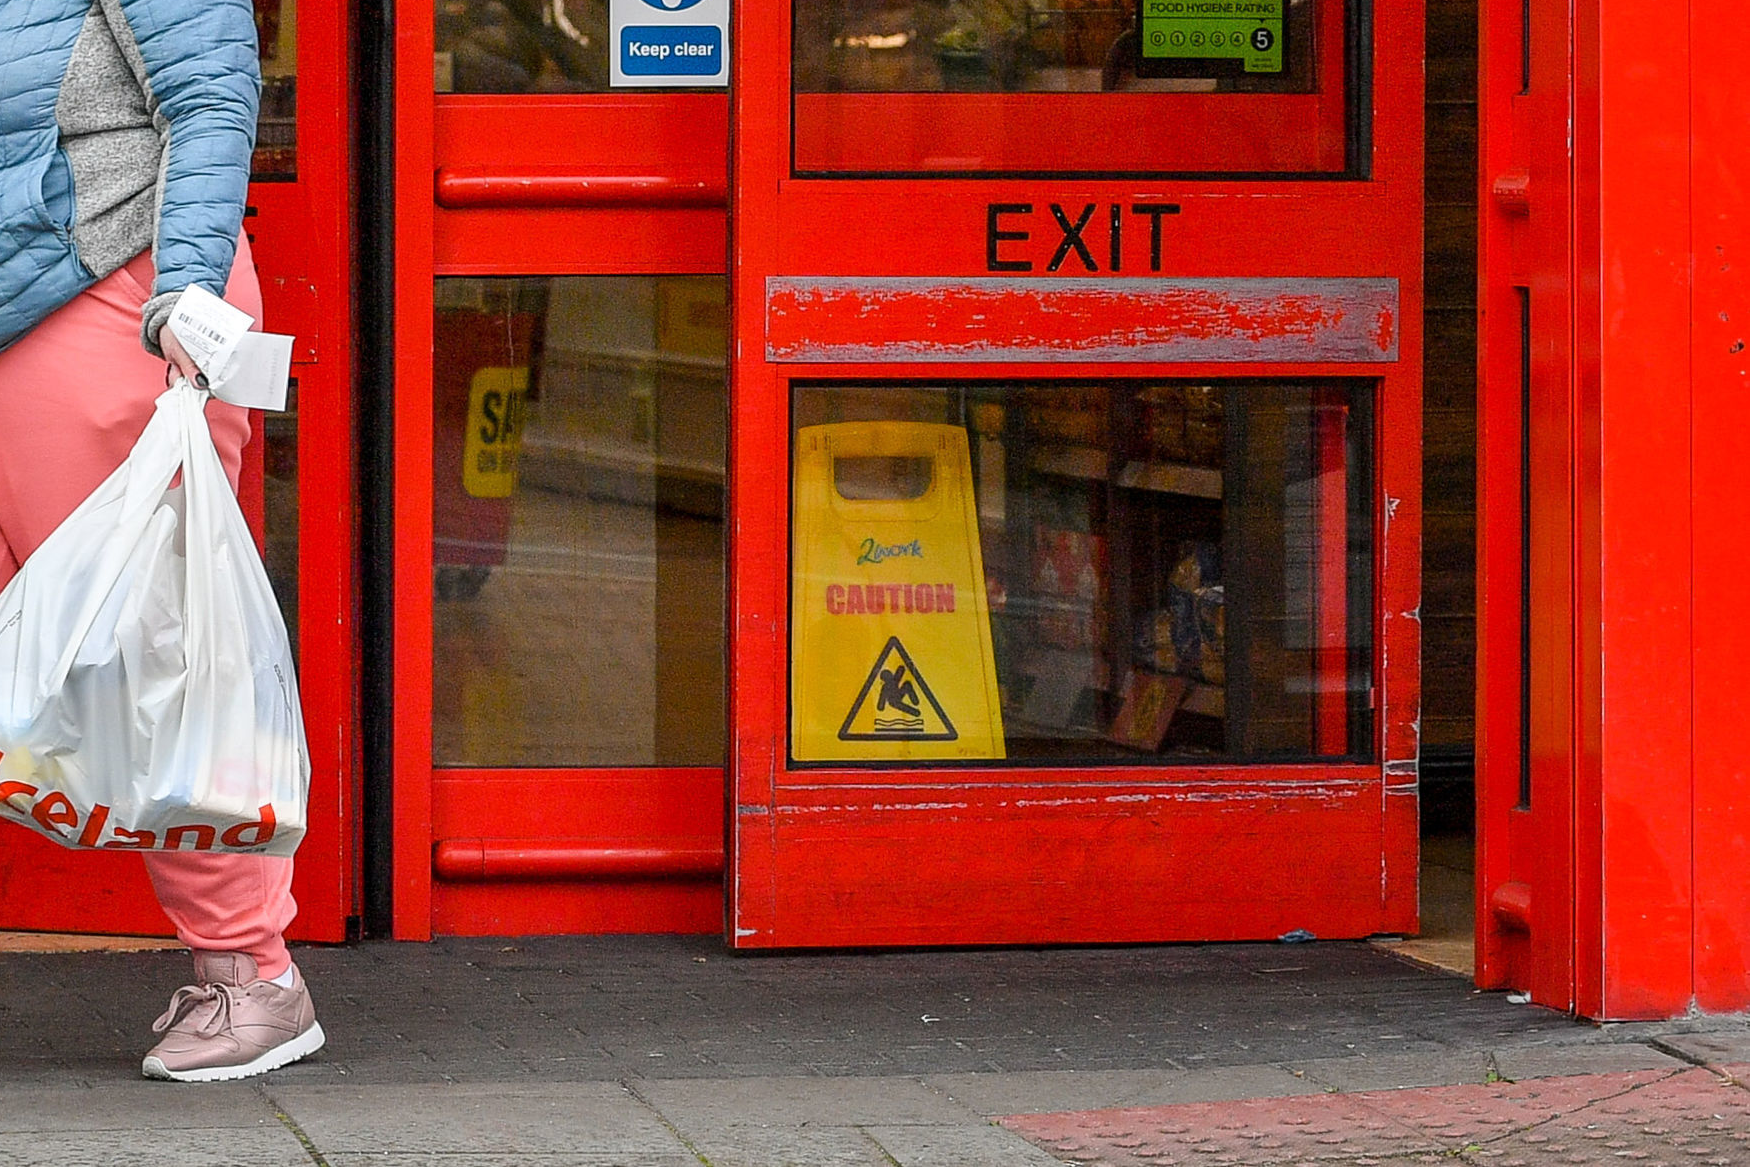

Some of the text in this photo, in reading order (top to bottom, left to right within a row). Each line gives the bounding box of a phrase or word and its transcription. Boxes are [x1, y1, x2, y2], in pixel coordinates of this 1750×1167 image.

[1150, 2, 1276, 14] FOOD HYGIENE RATING
[1256, 30, 1268, 49] 5
[629, 41, 714, 60] Keep clear
[986, 202, 1182, 273] EXIT
[825, 582, 957, 616] CAUTION
